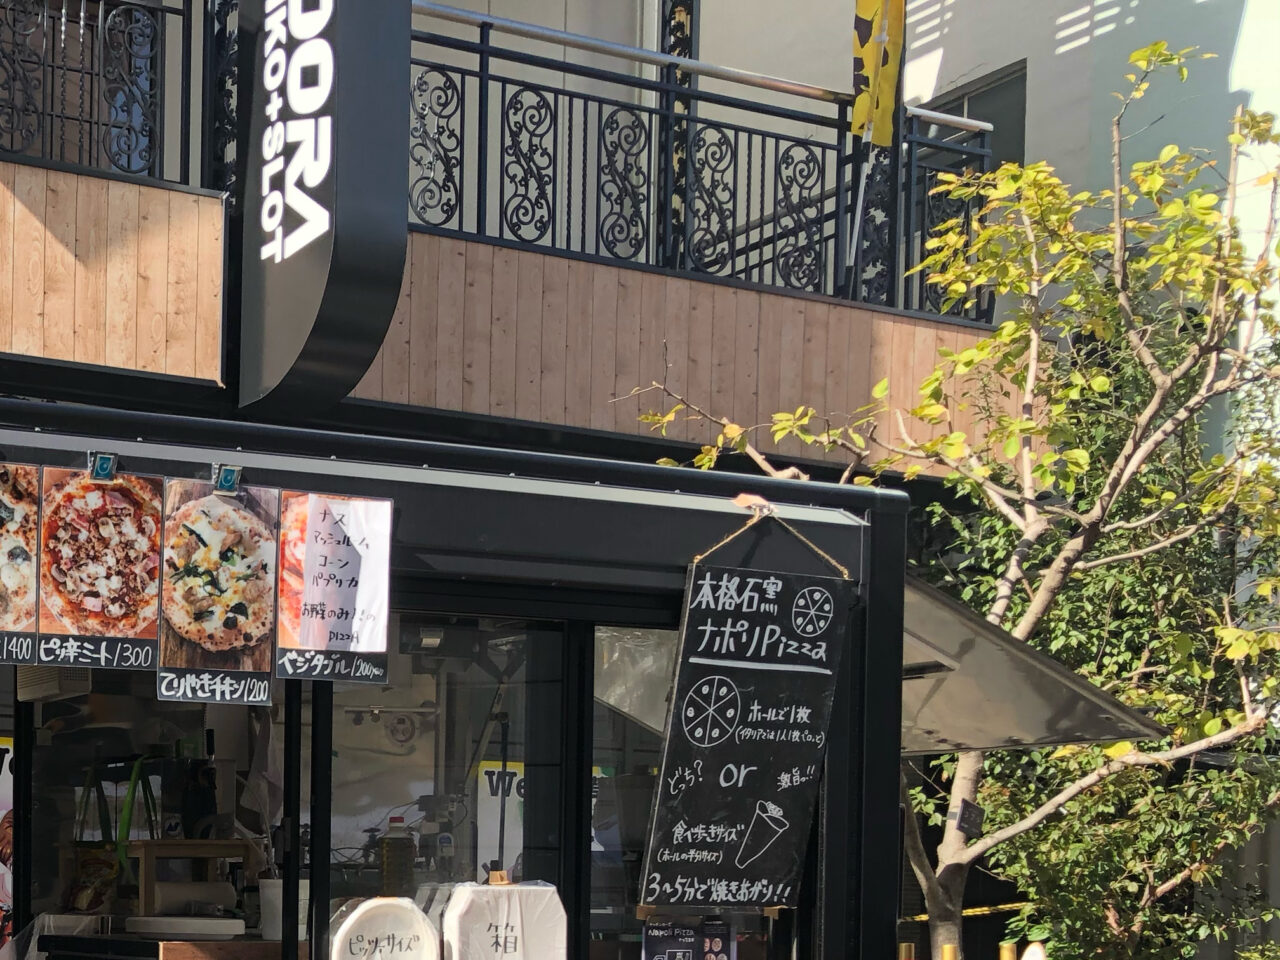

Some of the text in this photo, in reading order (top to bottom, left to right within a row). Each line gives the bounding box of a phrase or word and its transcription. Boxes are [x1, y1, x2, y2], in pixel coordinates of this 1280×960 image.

[261, 0, 287, 263] KO+SLOT
[319, 554, 350, 569] コーン
[312, 571, 359, 588] パプリカ
[719, 763, 758, 788] or
[486, 922, 519, 954] 箱
